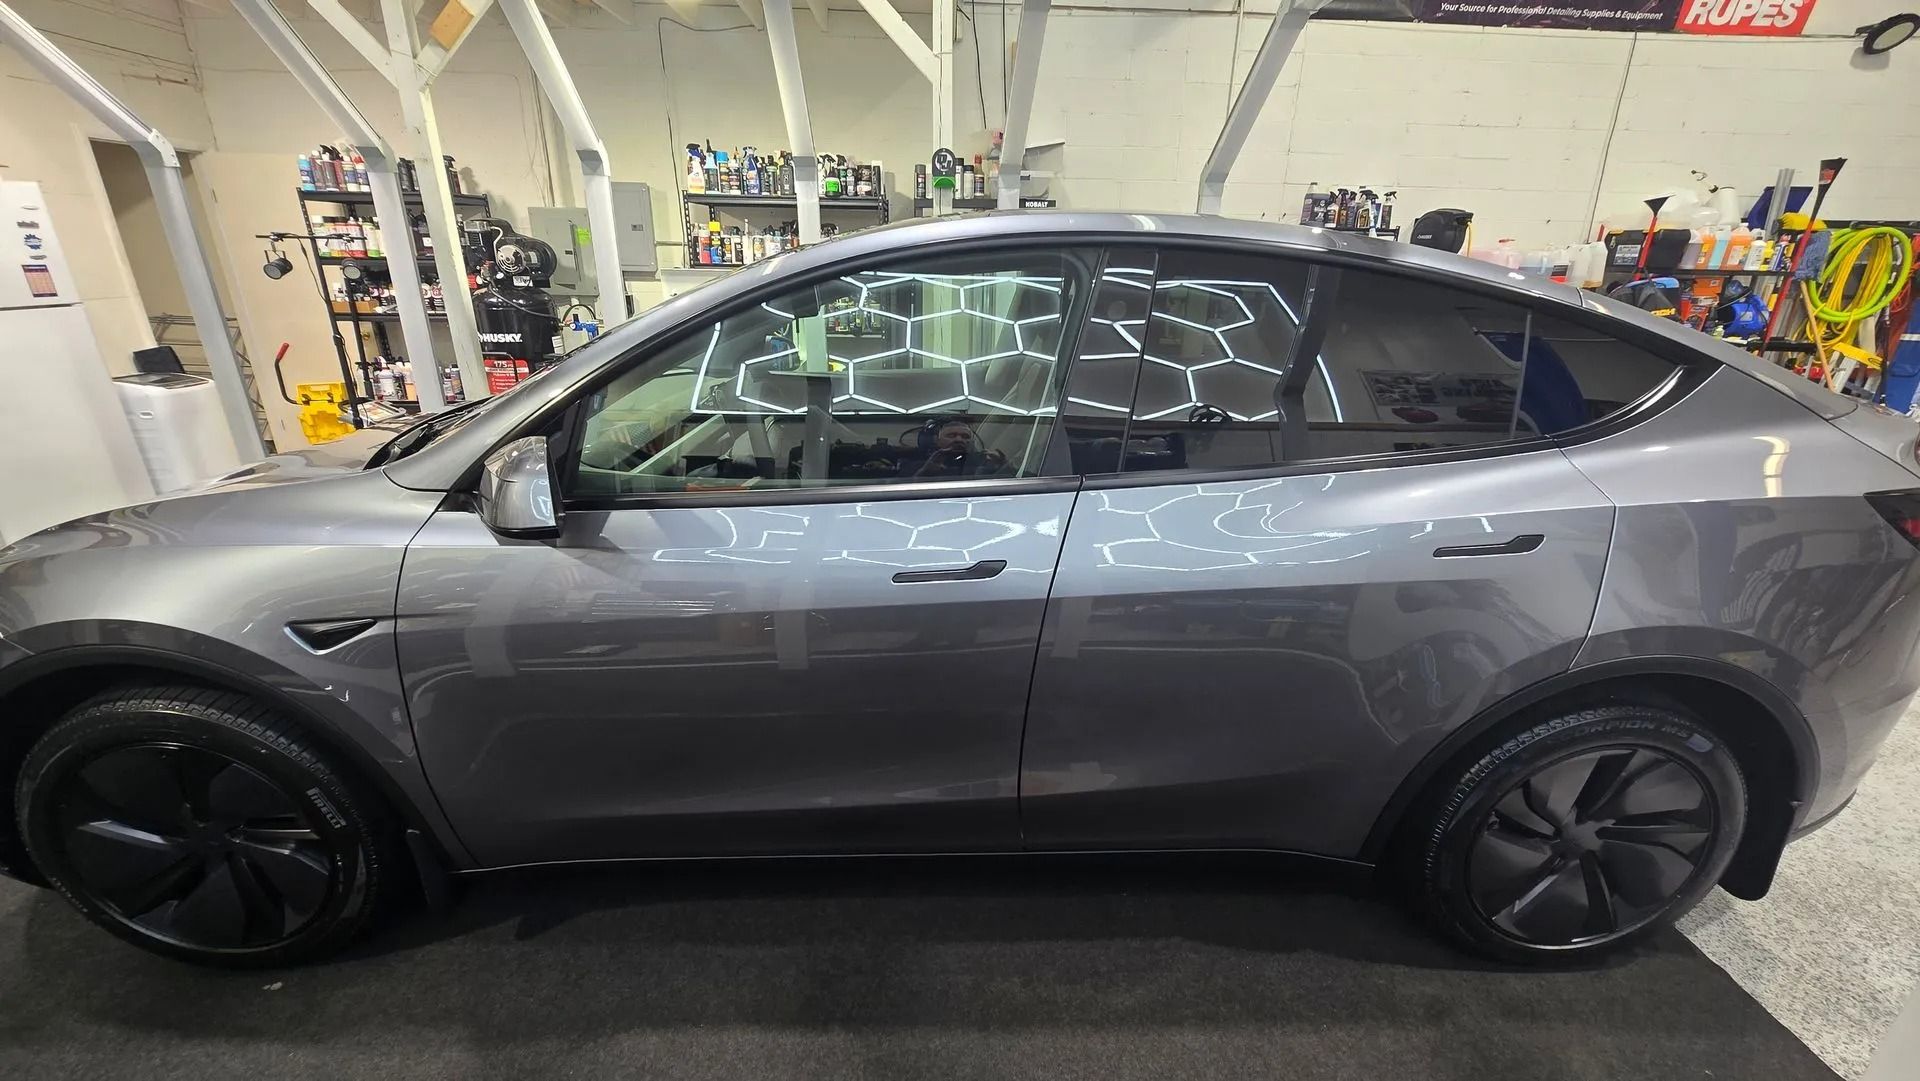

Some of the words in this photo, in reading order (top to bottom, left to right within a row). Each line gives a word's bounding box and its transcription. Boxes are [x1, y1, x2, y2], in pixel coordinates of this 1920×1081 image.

[1440, 2, 1459, 11] Your
[1459, 4, 1486, 13] Source
[1486, 5, 1499, 13] for
[1498, 5, 1546, 15] Professional
[1546, 7, 1582, 18] Detailing
[1581, 9, 1615, 19] Supplies
[1615, 10, 1622, 18] &
[1621, 11, 1664, 20] Equipment
[1683, 0, 1803, 28] RUPES
[305, 786, 347, 829] PIRELLI
